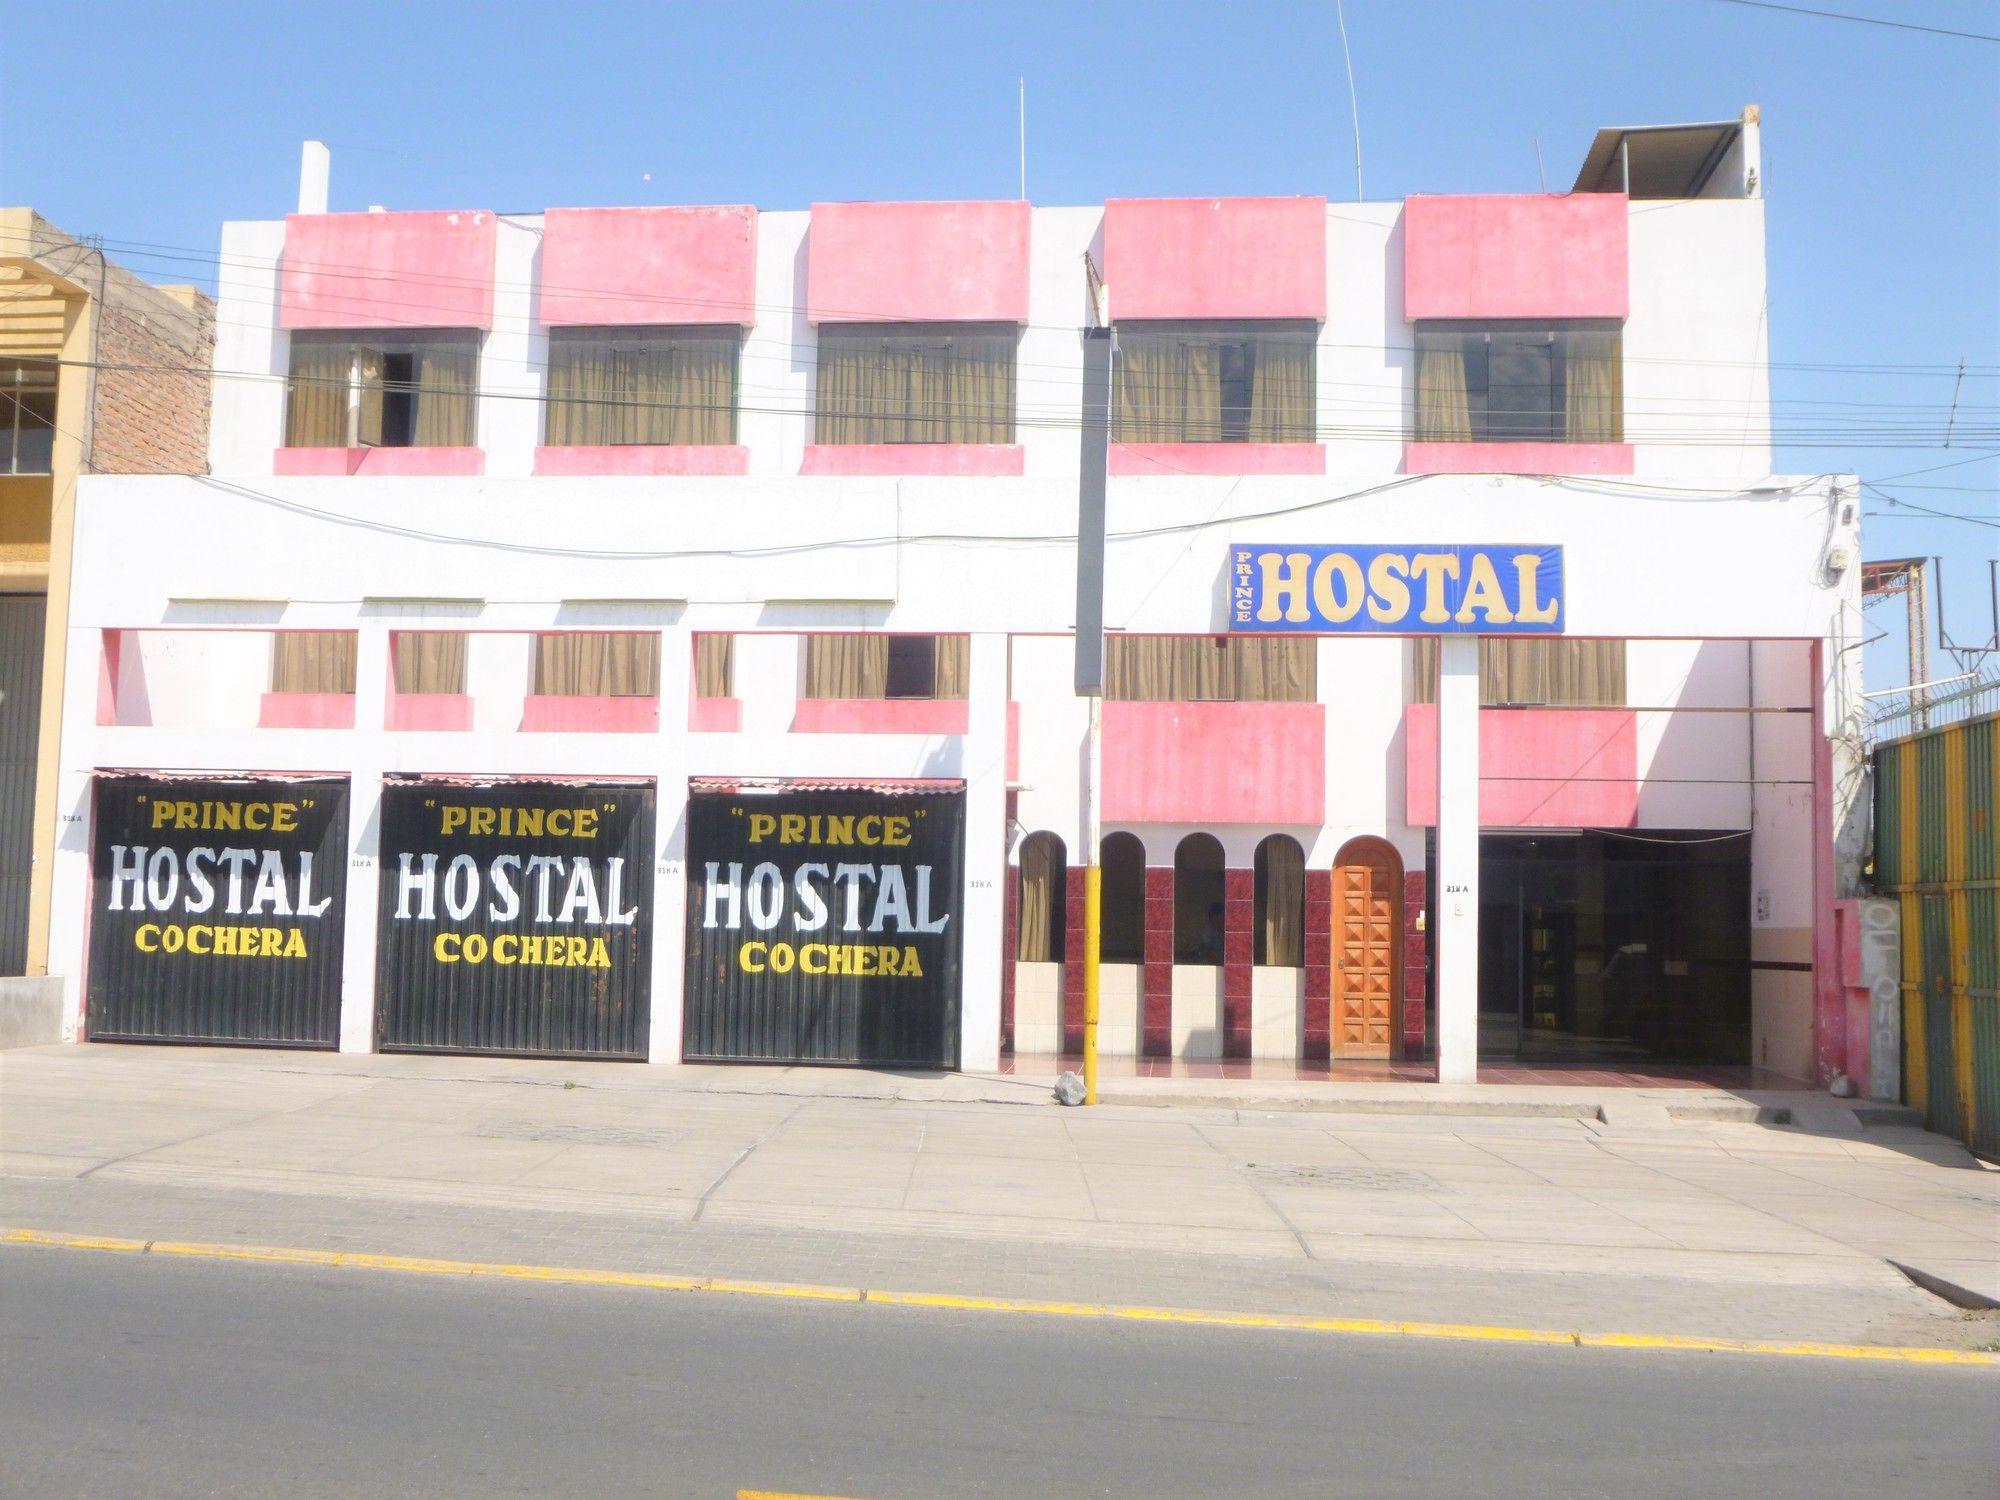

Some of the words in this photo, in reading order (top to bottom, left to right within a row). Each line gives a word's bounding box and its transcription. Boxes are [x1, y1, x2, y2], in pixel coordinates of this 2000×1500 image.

[1234, 551, 1253, 623] PRINCE
[1256, 552, 1559, 623] HOSTAL
[108, 845, 332, 917] HOSTAL
[394, 853, 639, 925] HOSTAL
[703, 861, 950, 934] HOSTAL
[135, 923, 308, 958] COCHERA
[434, 933, 612, 967] COCHERA
[739, 941, 923, 977] COCHERA
